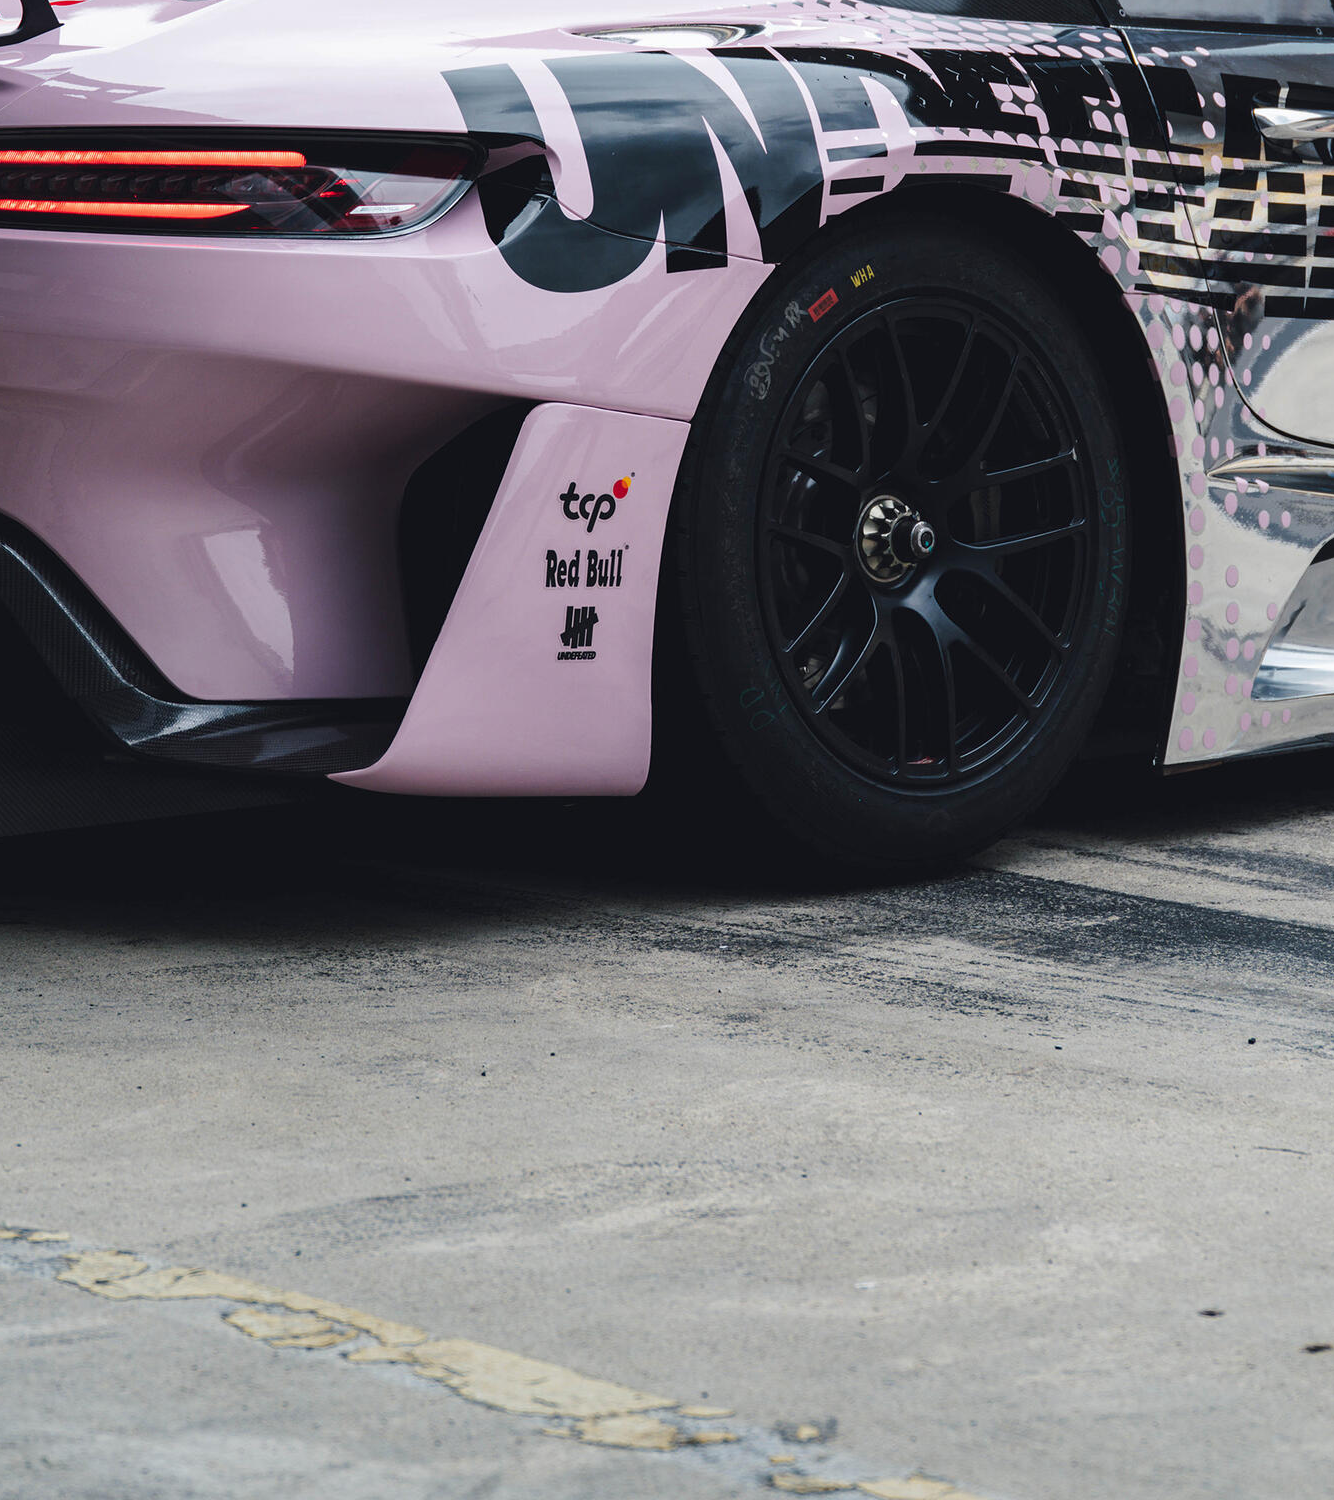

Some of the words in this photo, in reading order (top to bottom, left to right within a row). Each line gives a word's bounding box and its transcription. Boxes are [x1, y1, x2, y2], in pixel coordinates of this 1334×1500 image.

[850, 264, 875, 288] WHA
[559, 481, 617, 533] tcp
[545, 549, 581, 588] Red
[586, 549, 623, 588] Bull
[556, 650, 597, 661] UNDEFEATED
